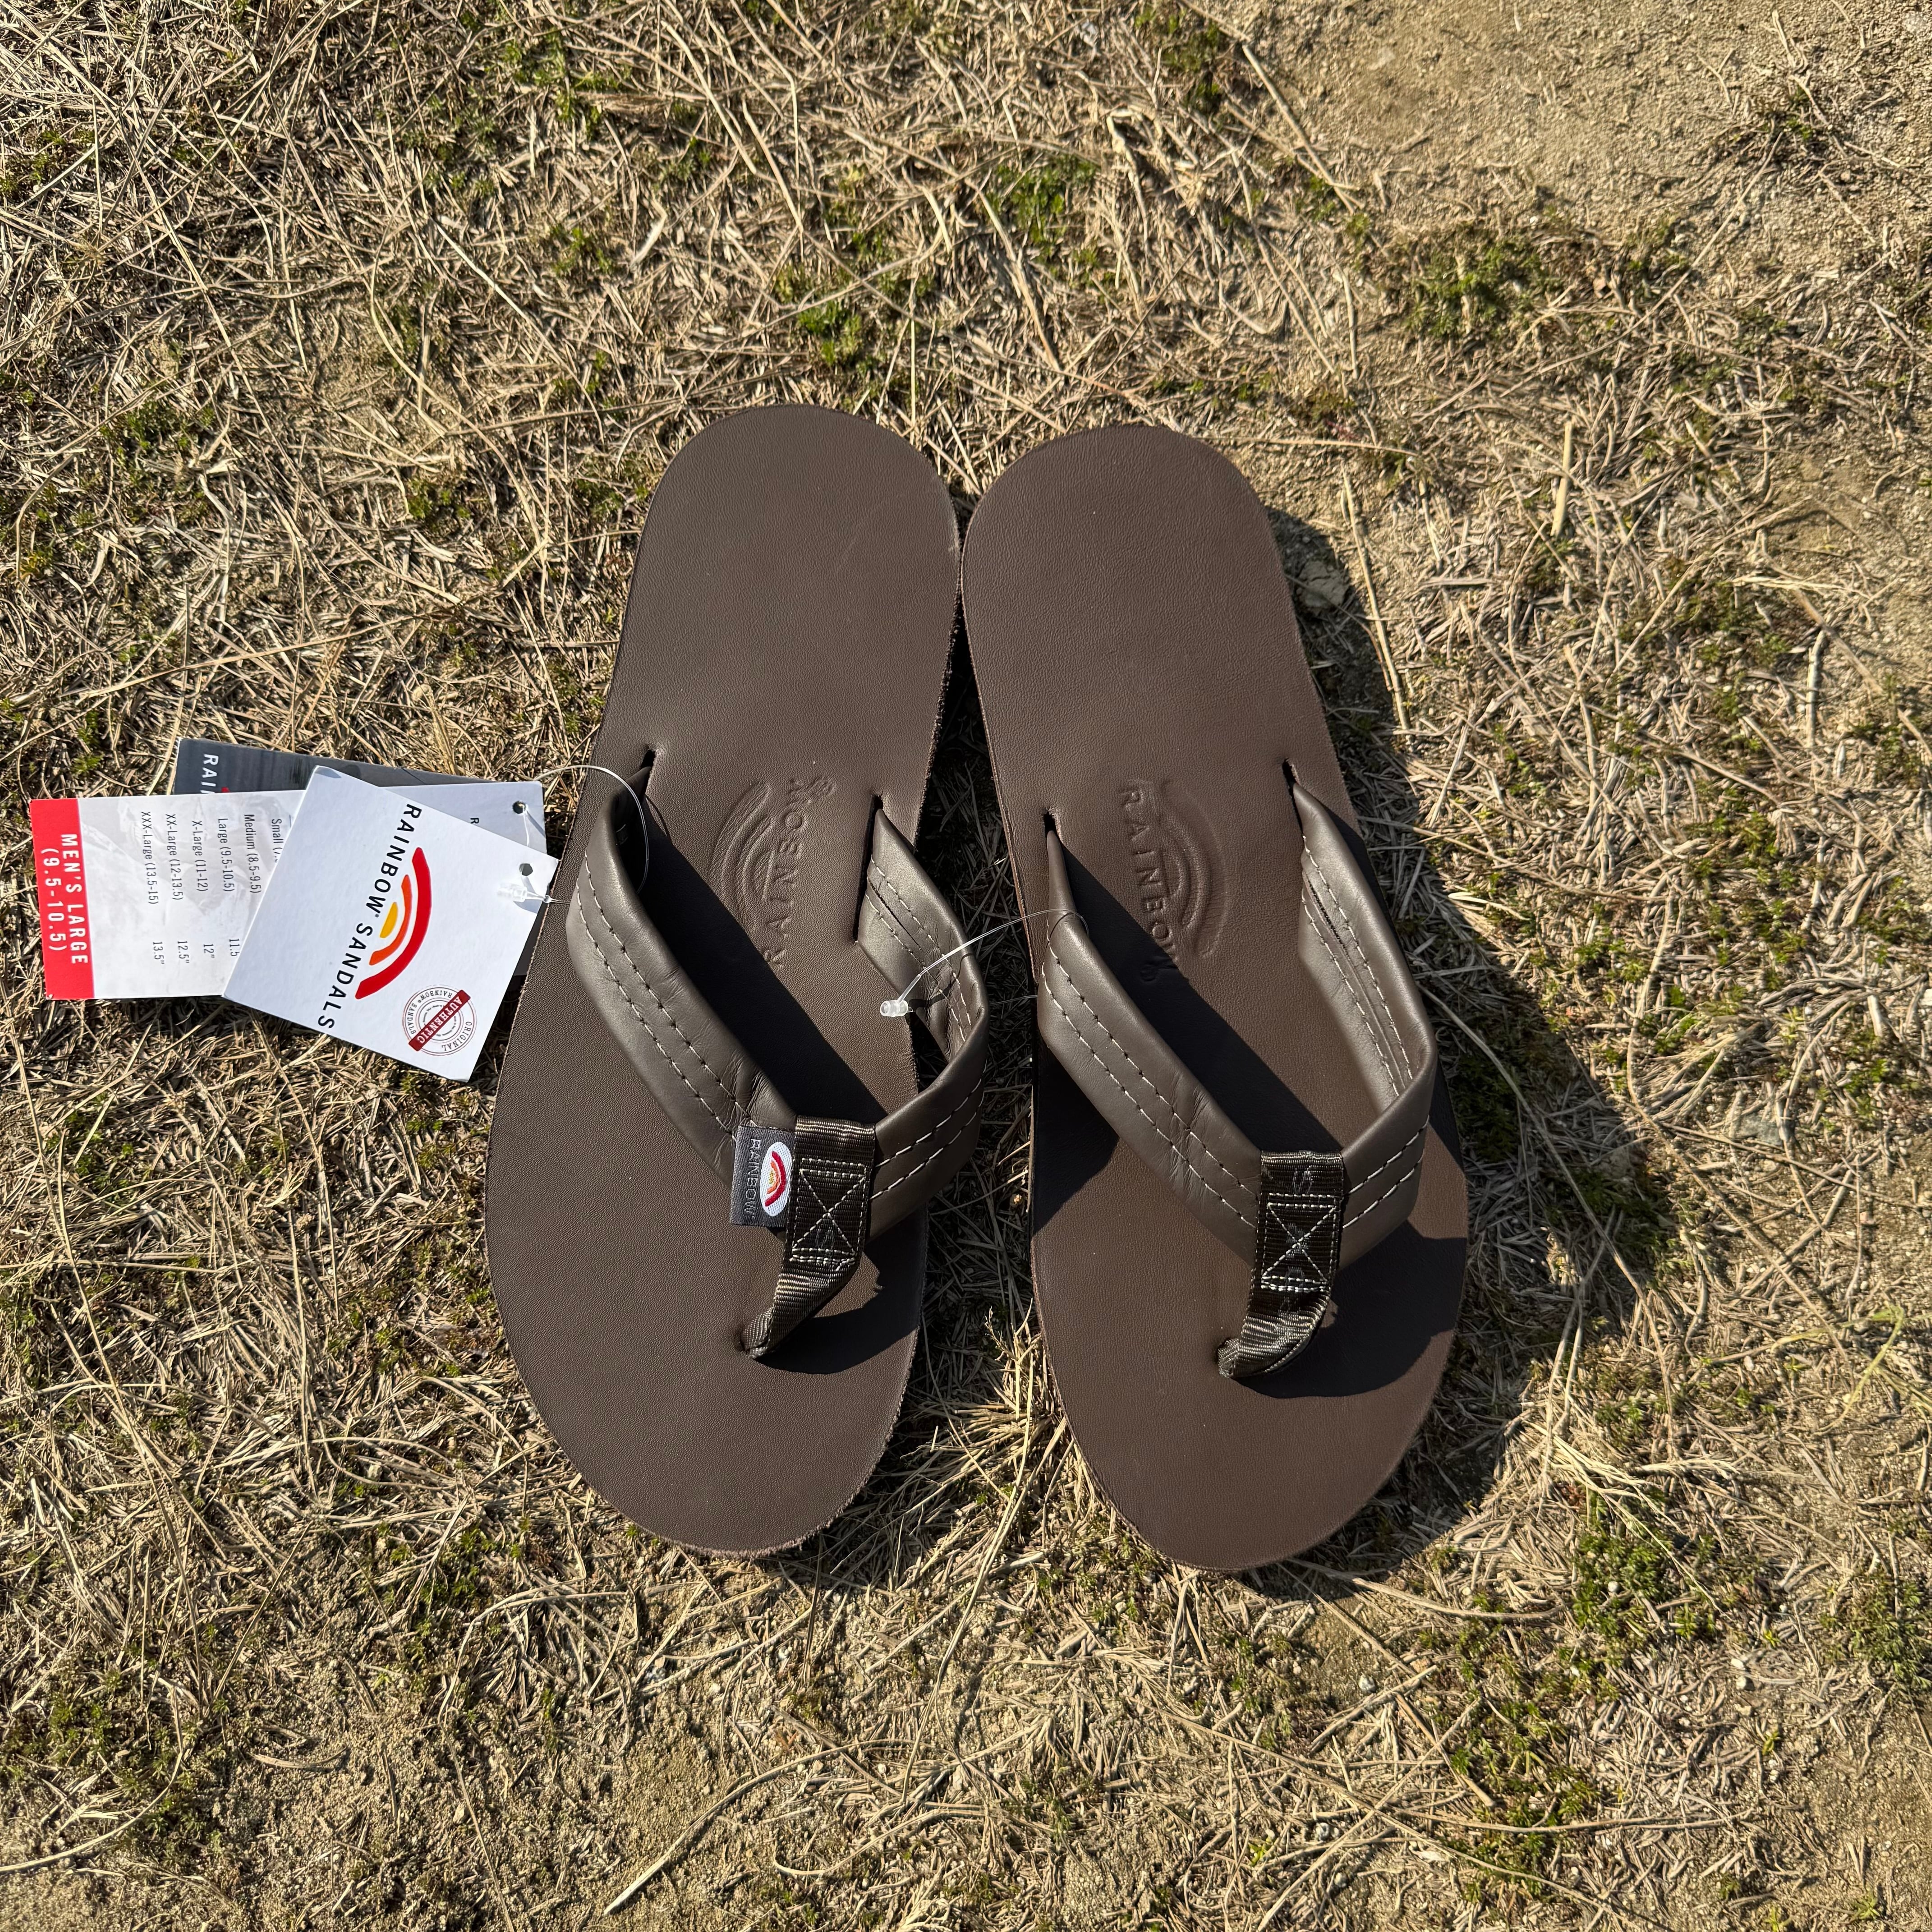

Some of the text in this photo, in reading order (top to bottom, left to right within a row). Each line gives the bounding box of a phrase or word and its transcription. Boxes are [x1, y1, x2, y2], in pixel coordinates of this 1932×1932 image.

[217, 818, 228, 844] Large
[244, 814, 262, 894] Medium (8.5-9.5)
[271, 819, 284, 843] Small
[60, 833, 88, 964] MEN'S LARGE
[141, 811, 165, 964] XXX-Large (13.5-15) 13.5"
[166, 814, 190, 963] XX-Large (12-13.5) 12.5"
[192, 821, 215, 958] X-Large (11-12) 12"
[220, 847, 235, 892] (9.5-10.5)
[318, 923, 373, 1029] SANDALS
[407, 1003, 417, 1035] SANDALS
[417, 996, 462, 1044] AUTHENTIC
[442, 1021, 472, 1051] ORIGINAL
